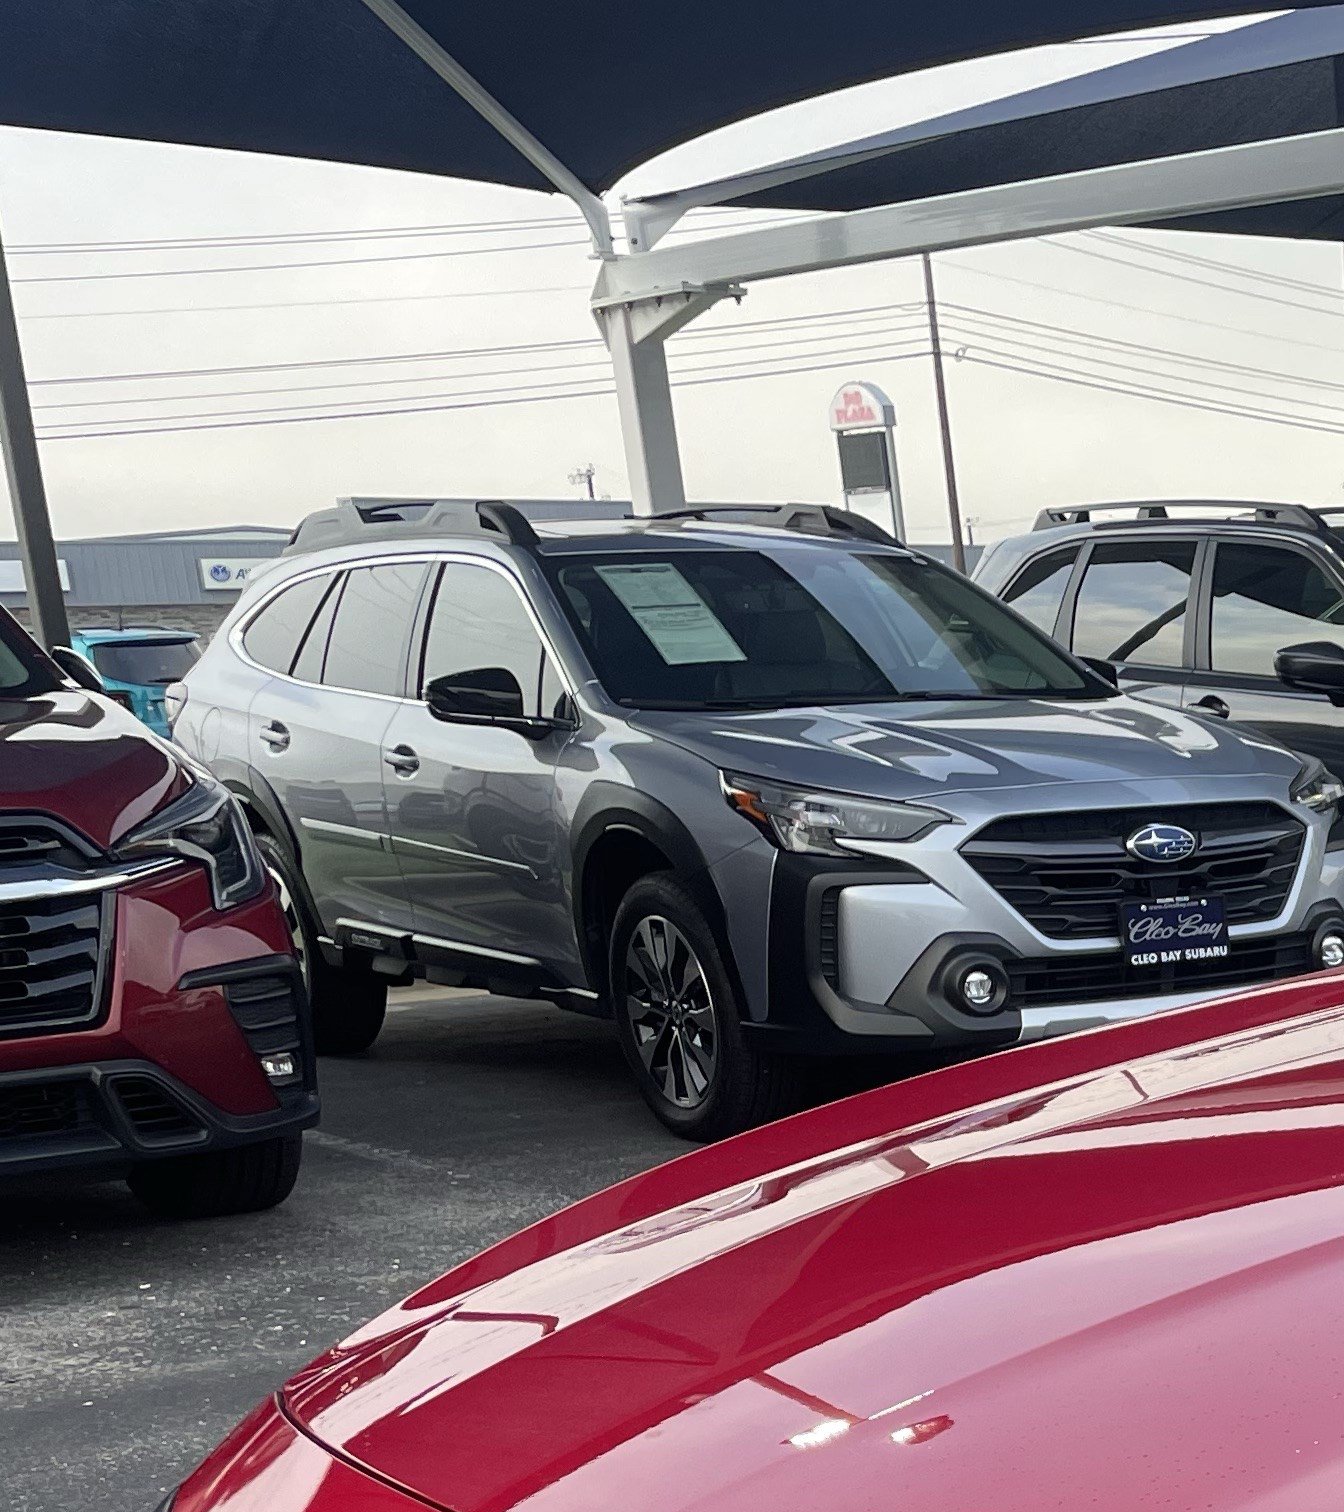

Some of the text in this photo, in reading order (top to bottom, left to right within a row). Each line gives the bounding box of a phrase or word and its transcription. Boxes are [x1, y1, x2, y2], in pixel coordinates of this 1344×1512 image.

[1177, 913, 1223, 940] Bay
[1131, 945, 1228, 966] CLEO BAY SUBARU
